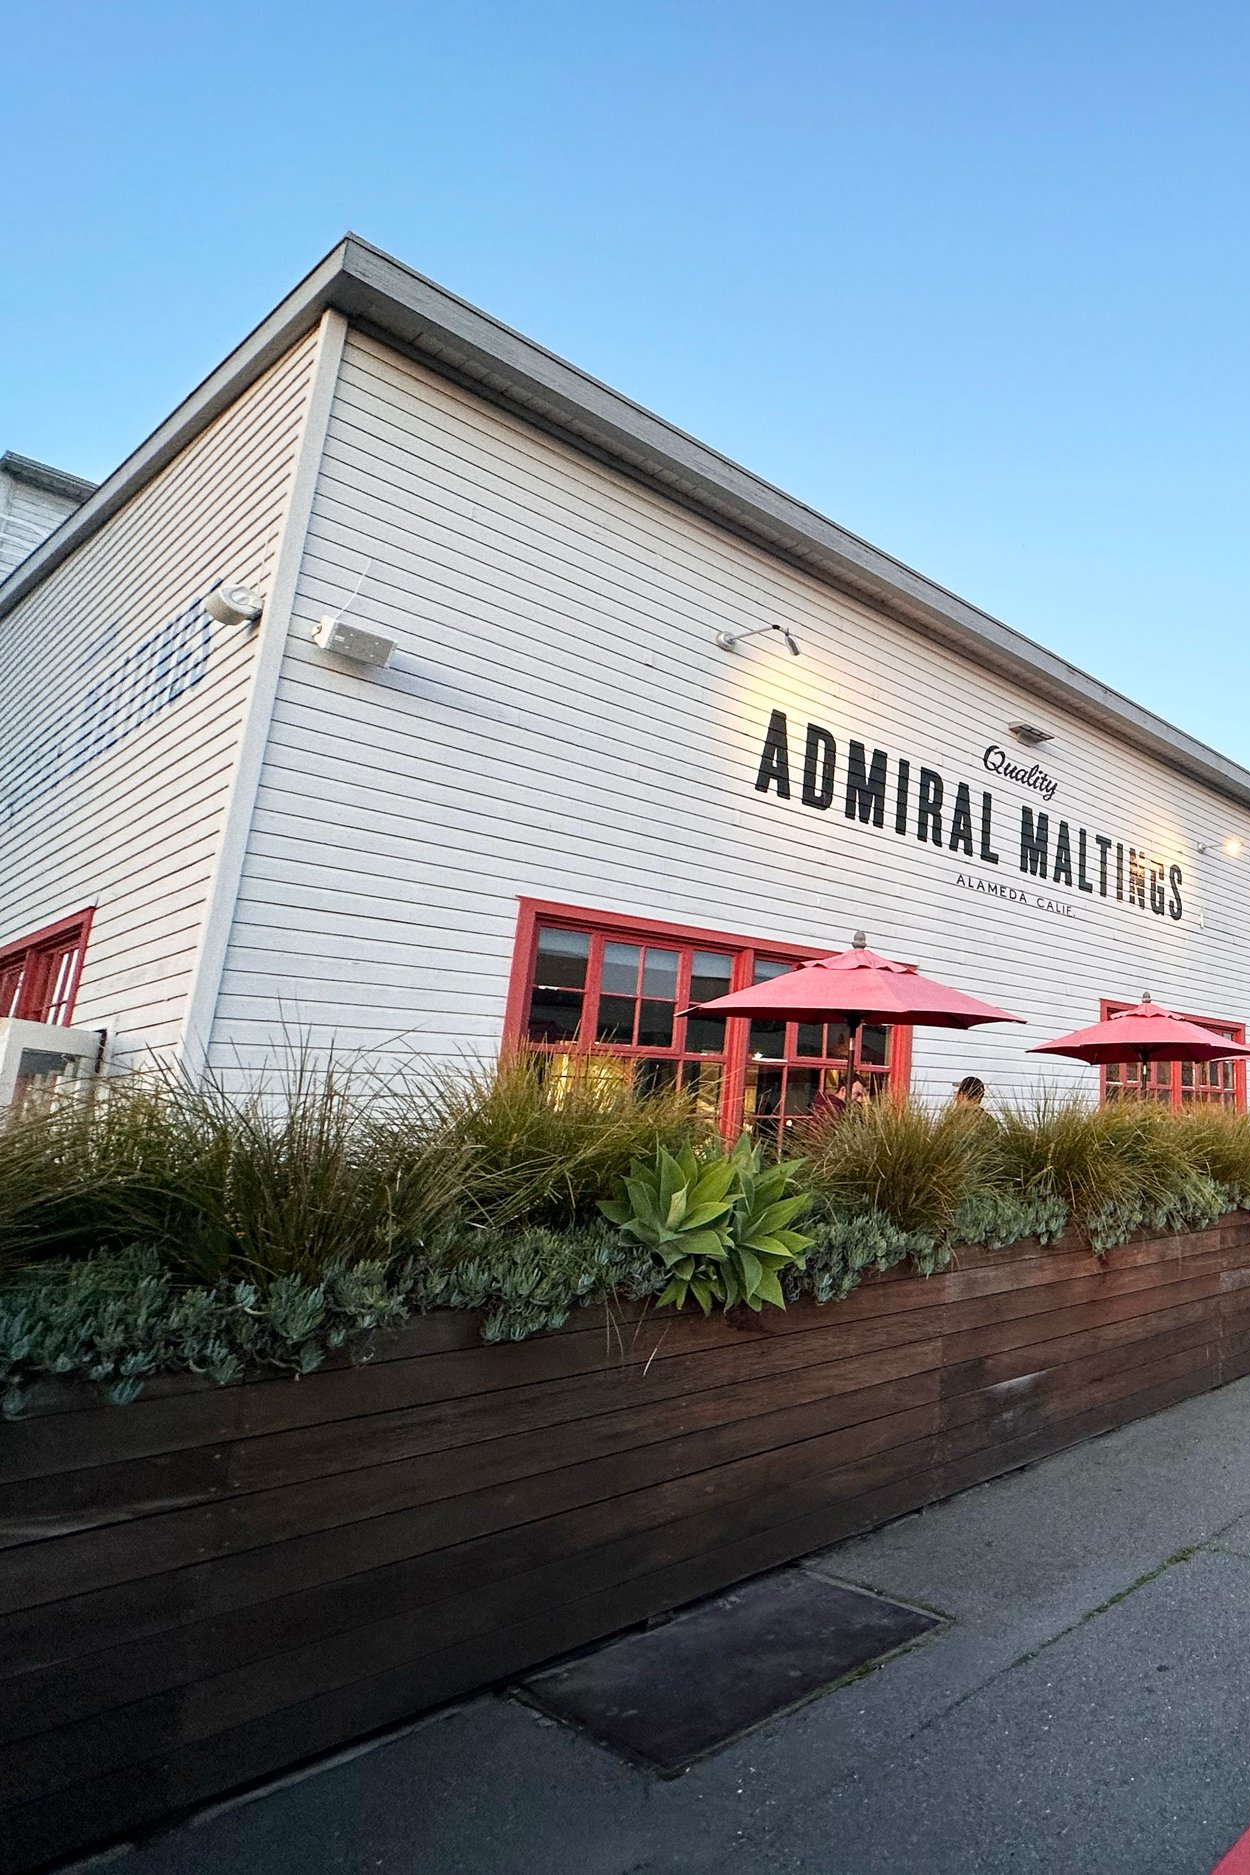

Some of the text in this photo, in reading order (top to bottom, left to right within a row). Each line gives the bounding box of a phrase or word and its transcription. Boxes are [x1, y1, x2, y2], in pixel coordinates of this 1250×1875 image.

[982, 745, 1059, 801] Quality
[754, 708, 1183, 921] ADMIRAL MALTINGS
[956, 874, 1028, 903] ALAMEDA
